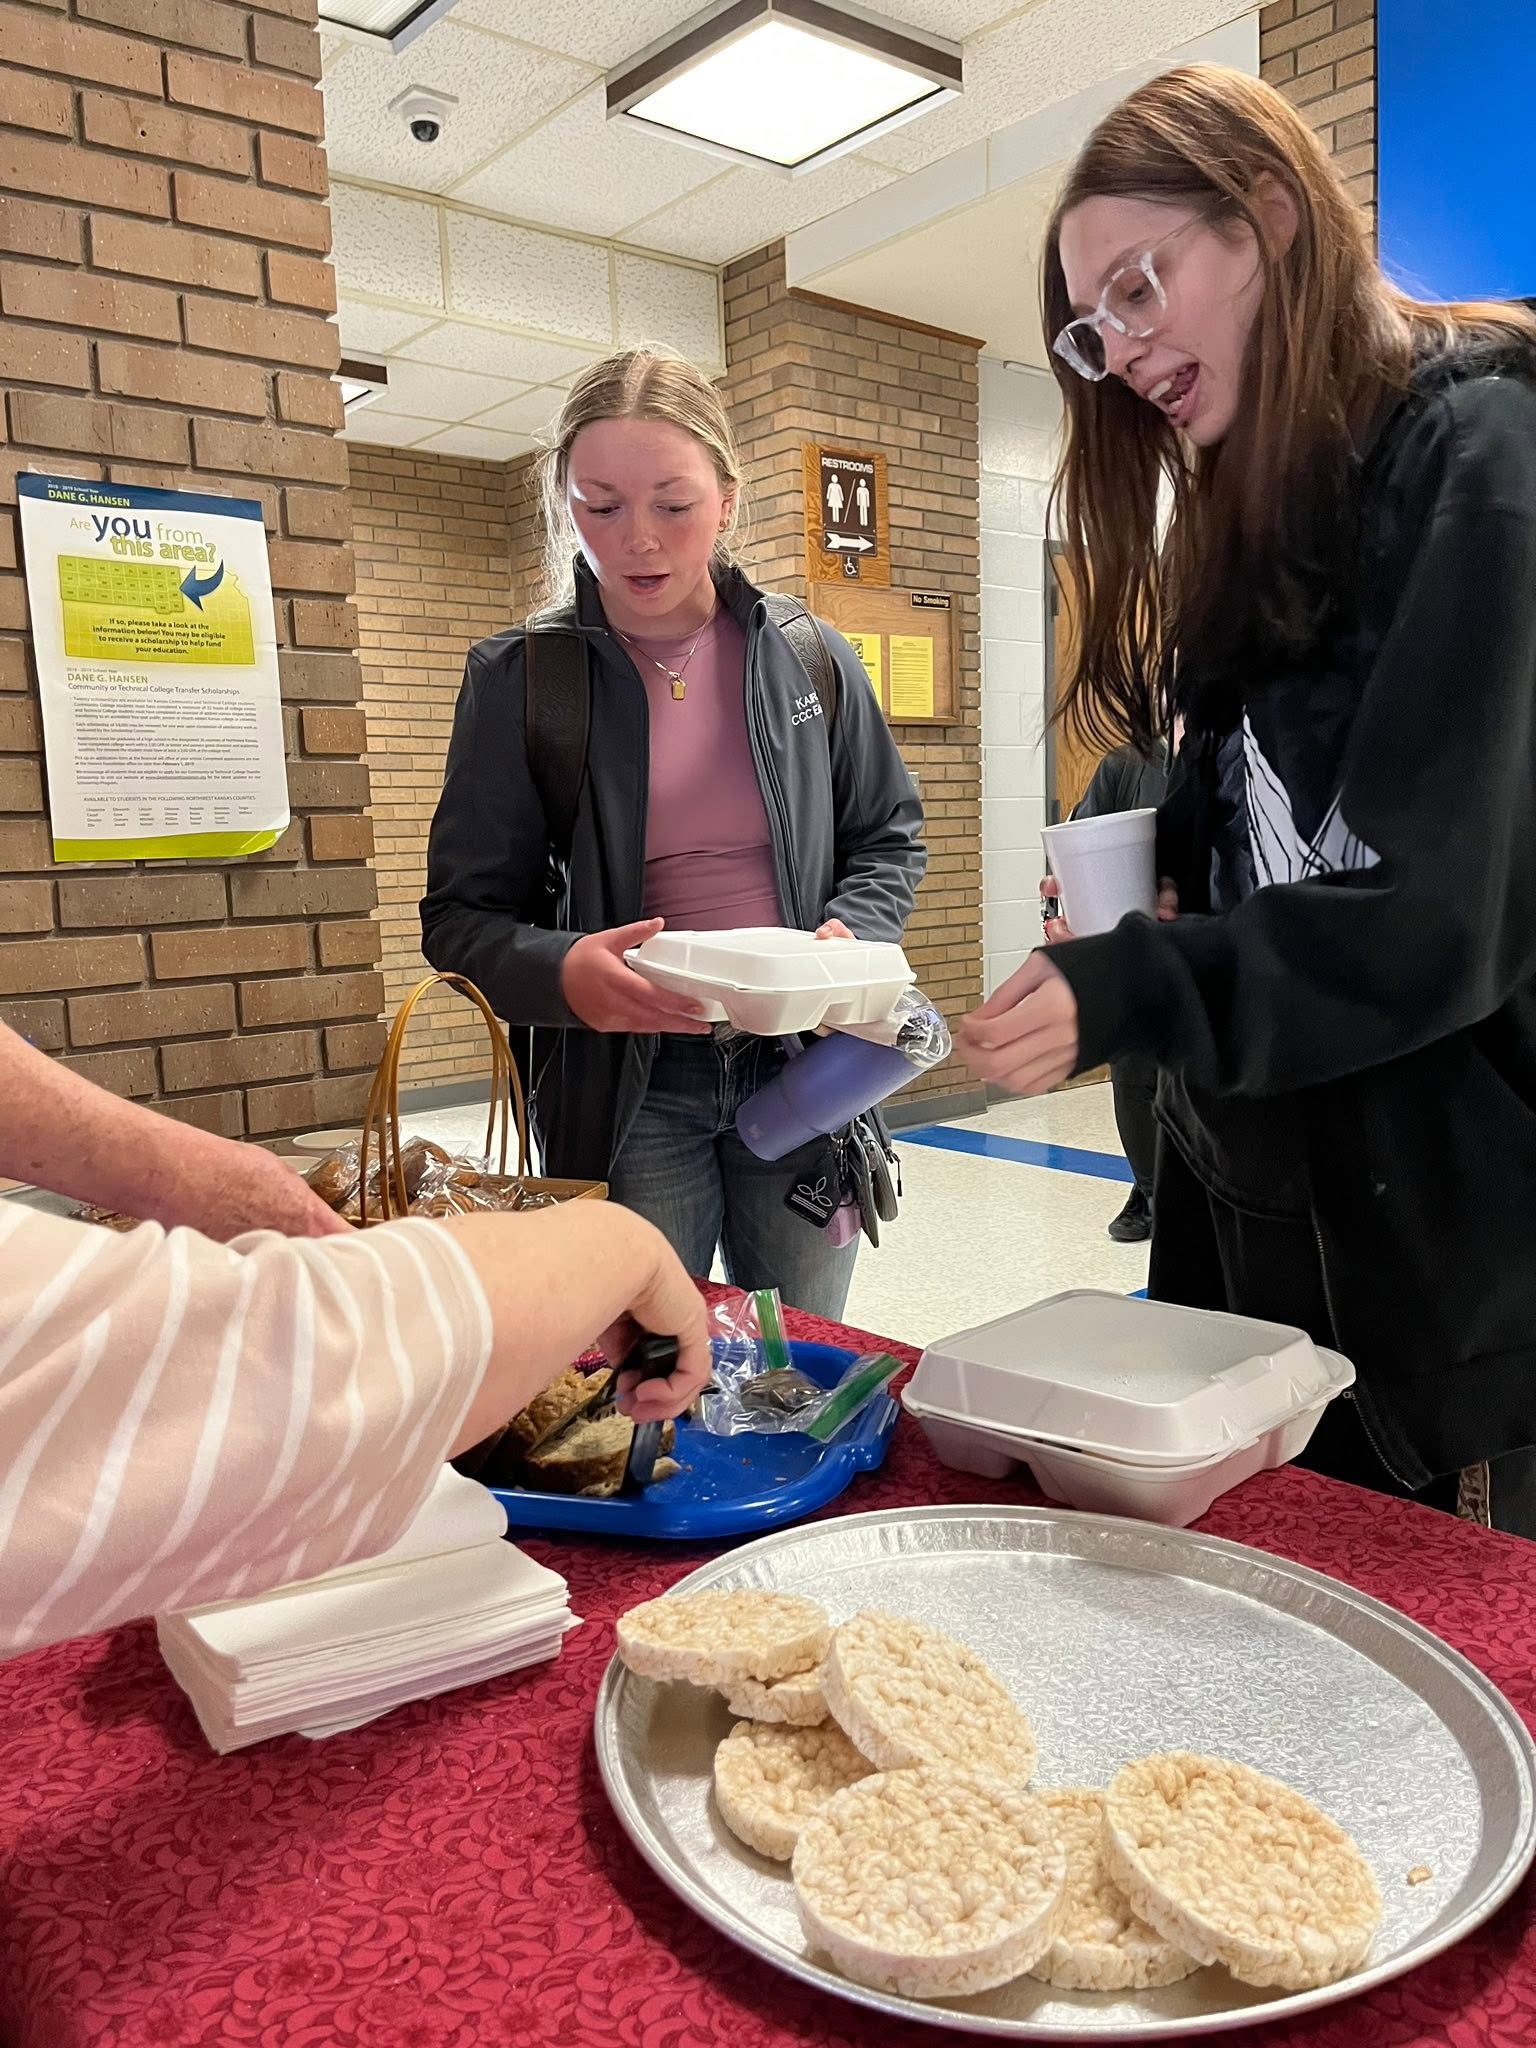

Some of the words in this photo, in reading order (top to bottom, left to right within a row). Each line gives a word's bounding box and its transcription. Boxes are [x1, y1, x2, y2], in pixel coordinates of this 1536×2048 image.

[822, 457, 874, 474] RESTROOMS
[48, 490, 76, 501] DANE
[78, 493, 88, 502] G.
[90, 494, 130, 506] HANSEN
[70, 518, 91, 531] Are
[91, 514, 151, 542] you
[156, 525, 203, 544] from
[110, 533, 154, 558] this
[160, 542, 216, 562] area?
[913, 595, 922, 603] No
[924, 596, 949, 607] Smoking
[128, 619, 150, 627] please
[93, 626, 136, 634] information
[201, 632, 225, 640] eligible
[140, 638, 180, 646] scholarship
[68, 673, 94, 682] DANE
[97, 674, 108, 682] G.
[109, 675, 148, 684] HANSEN
[68, 683, 108, 692] Community
[150, 686, 174, 694] College
[792, 708, 813, 726] CCC
